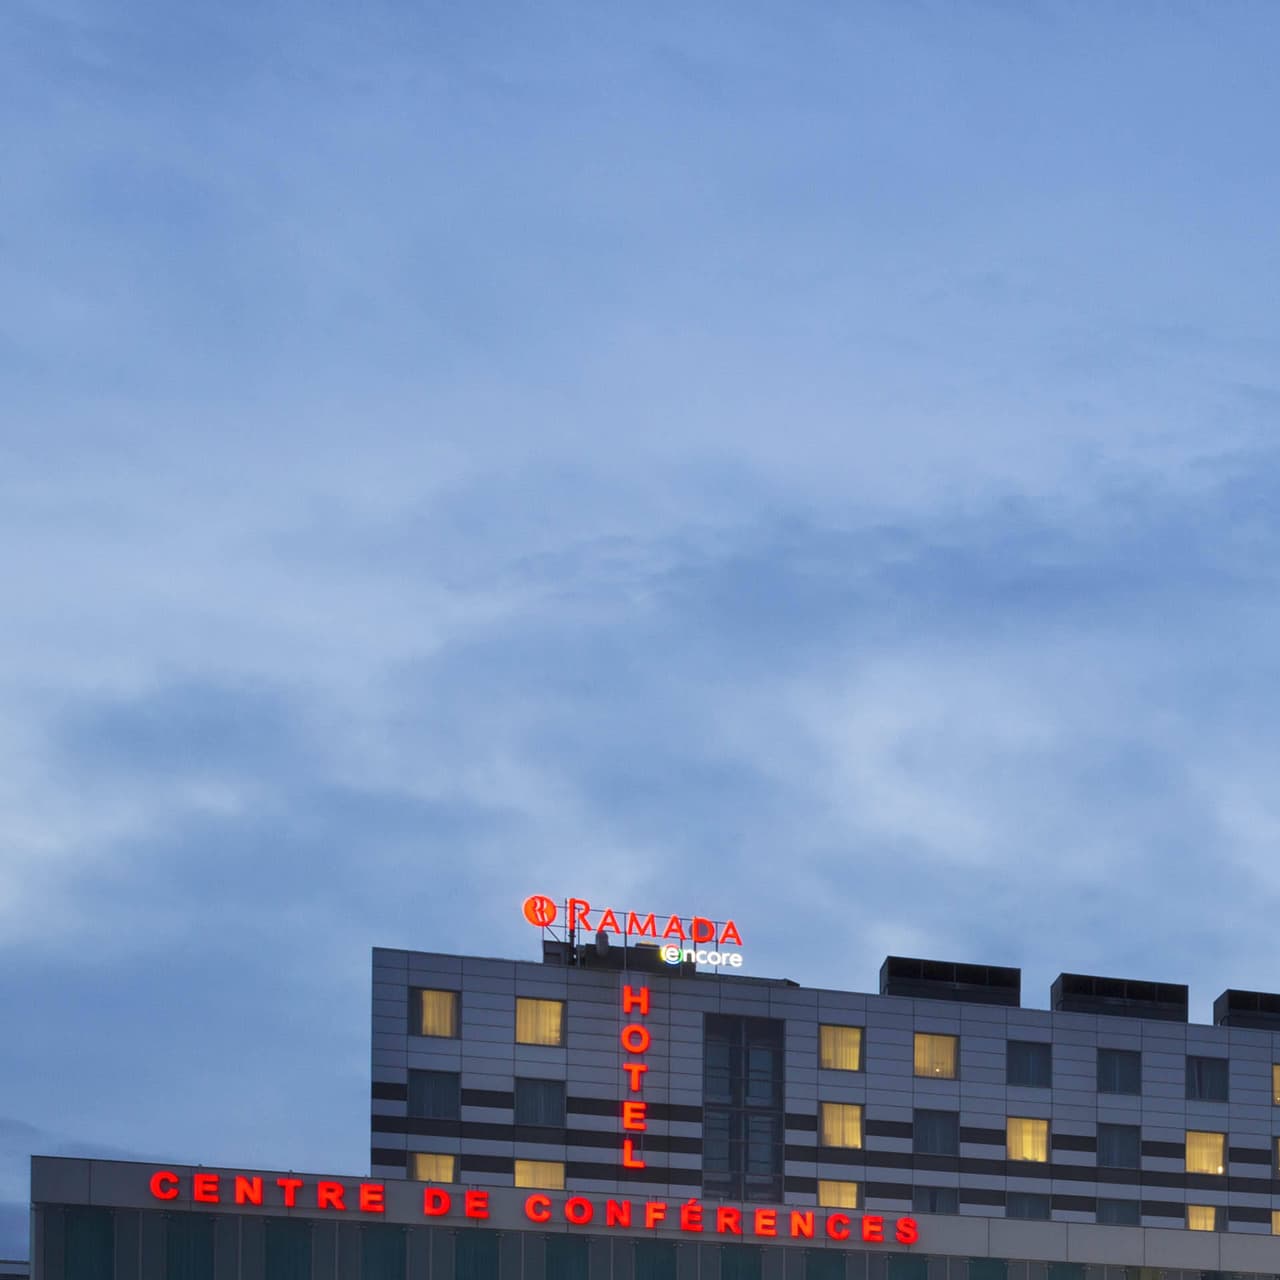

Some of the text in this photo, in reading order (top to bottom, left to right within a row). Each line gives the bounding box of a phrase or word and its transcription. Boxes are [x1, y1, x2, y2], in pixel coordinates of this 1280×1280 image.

[567, 897, 743, 946] RAMADA
[660, 944, 743, 968] encore
[621, 984, 650, 1169] HOTEL
[148, 1170, 920, 1244] CENTRE DE CONFÉRENCES
